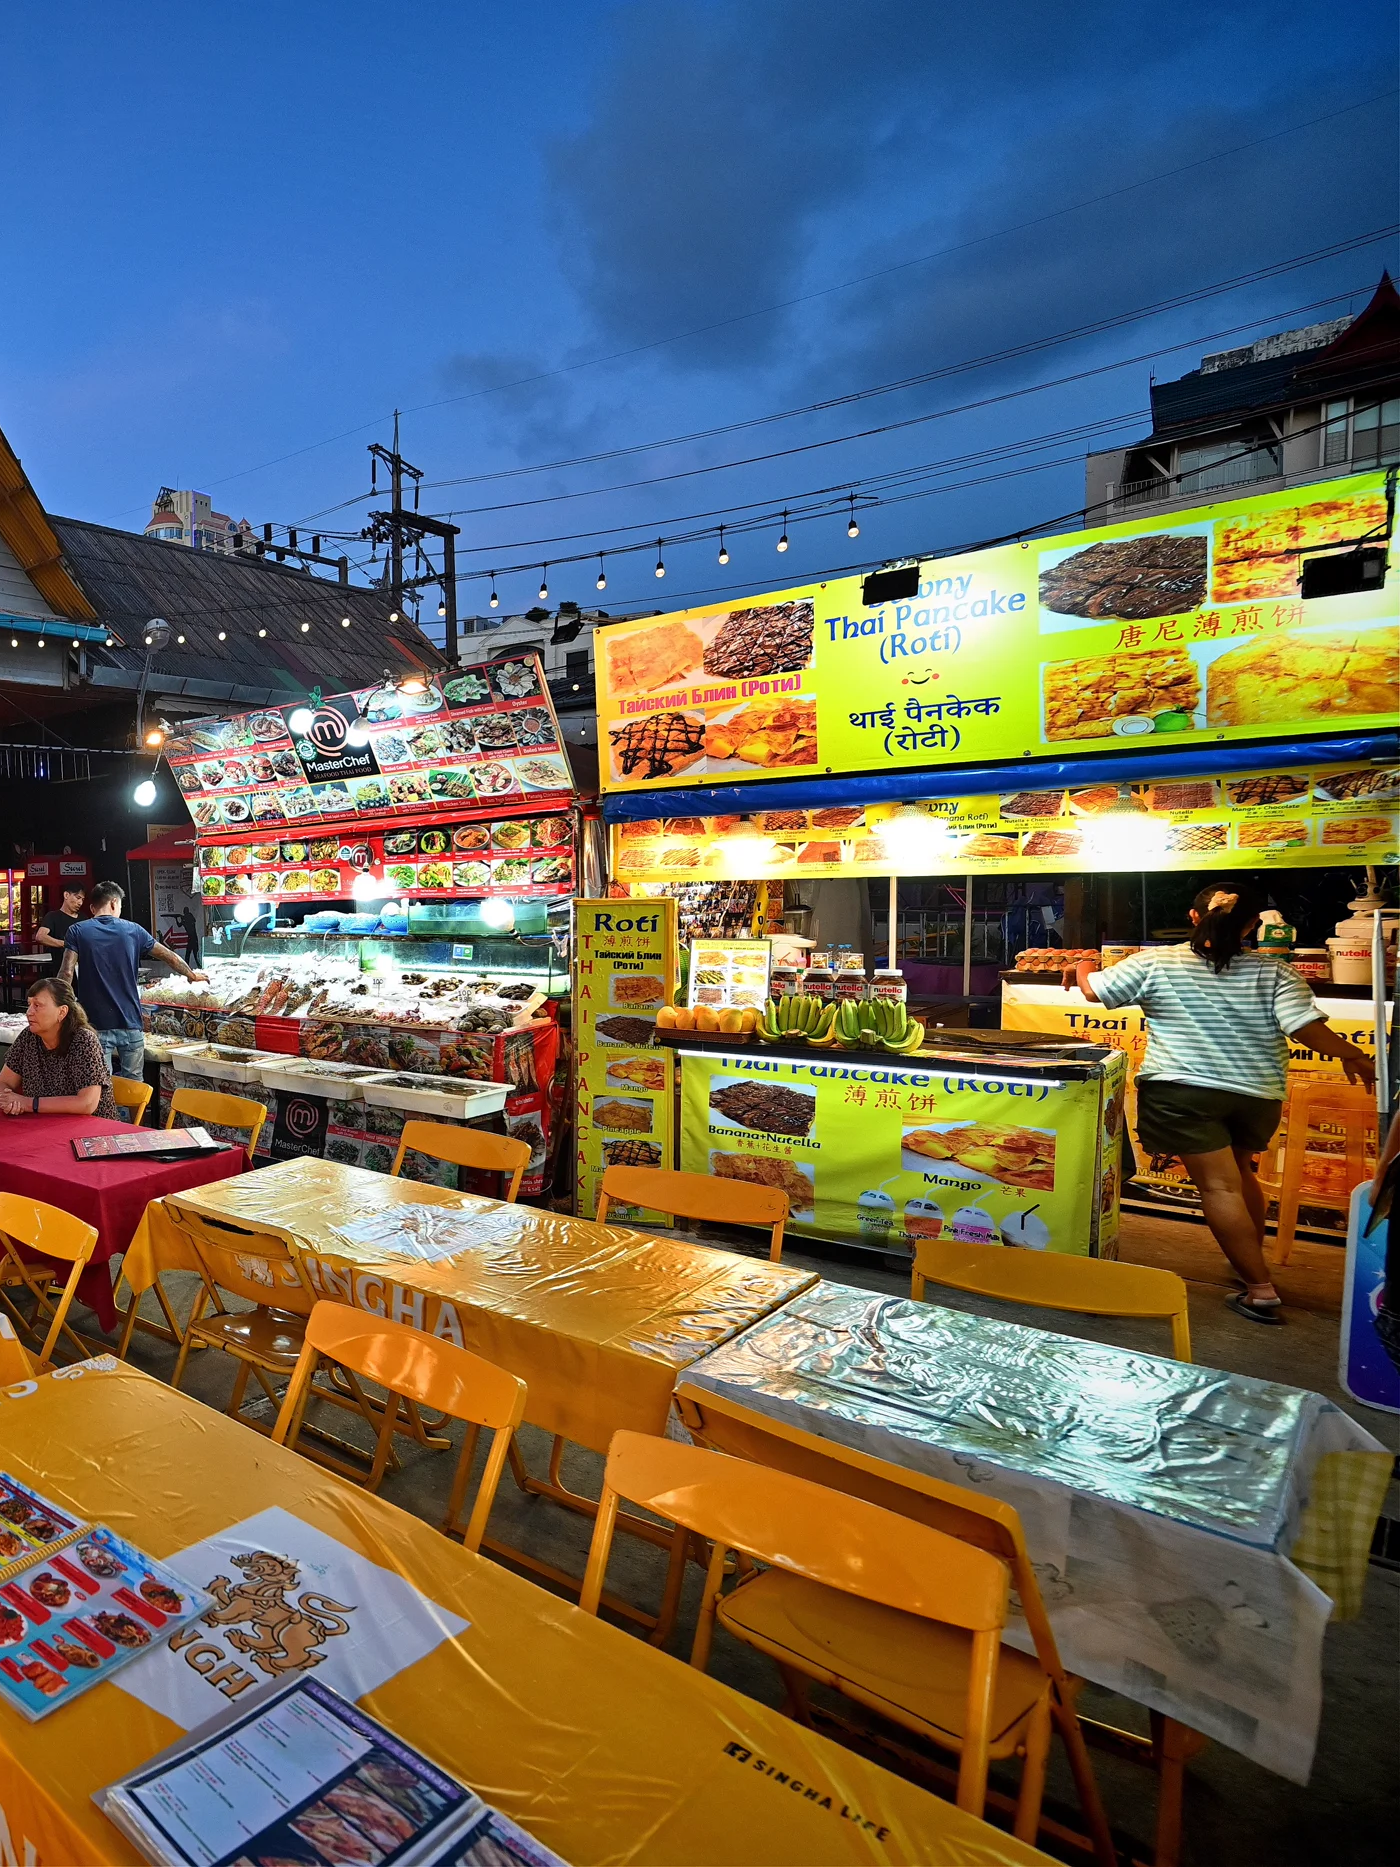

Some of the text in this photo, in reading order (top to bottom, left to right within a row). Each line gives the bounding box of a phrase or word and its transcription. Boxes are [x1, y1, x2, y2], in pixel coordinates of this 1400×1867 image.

[825, 589, 1026, 641] Thai Pancake
[1114, 601, 1308, 650] 唐尼薄煎饼
[879, 625, 962, 664] (Roti)
[619, 674, 801, 715] Тайский Блин (Роти)
[512, 699, 528, 708] Oyster
[849, 693, 1001, 730] थाई पैनकेक
[883, 725, 961, 757] (रोटी)
[306, 754, 371, 773] MasterChef
[314, 771, 340, 780] SEAFOOD
[355, 766, 372, 774] FOOD
[1231, 803, 1300, 814] Mango Chocolate
[595, 914, 660, 932] Roti
[603, 936, 651, 948] 薄煎饼
[595, 950, 662, 960] Тайский Блин
[613, 961, 644, 970] (Роти)
[580, 935, 593, 1024] THAI
[834, 984, 863, 992] nutella
[873, 985, 903, 994] nutella
[623, 1002, 654, 1010] Banana
[1065, 1013, 1129, 1030] Thai
[620, 1084, 649, 1092] Mango
[793, 1059, 930, 1087] Pancake
[943, 1072, 1050, 1103] (Roti)
[843, 1085, 938, 1114] 薄煎饼
[577, 1052, 590, 1215] PANCAKE
[602, 1126, 642, 1135] Pineapple
[708, 1125, 821, 1150] Banana+Nutella
[274, 1138, 321, 1156] MasterChef
[923, 1173, 982, 1192] Mango
[1136, 1166, 1185, 1182] Mango
[1000, 1186, 1027, 1198] 芒果
[856, 1213, 895, 1227] Green Tea
[960, 1228, 983, 1239] Fresh
[752, 1759, 891, 1843] SINGHA LIFE
